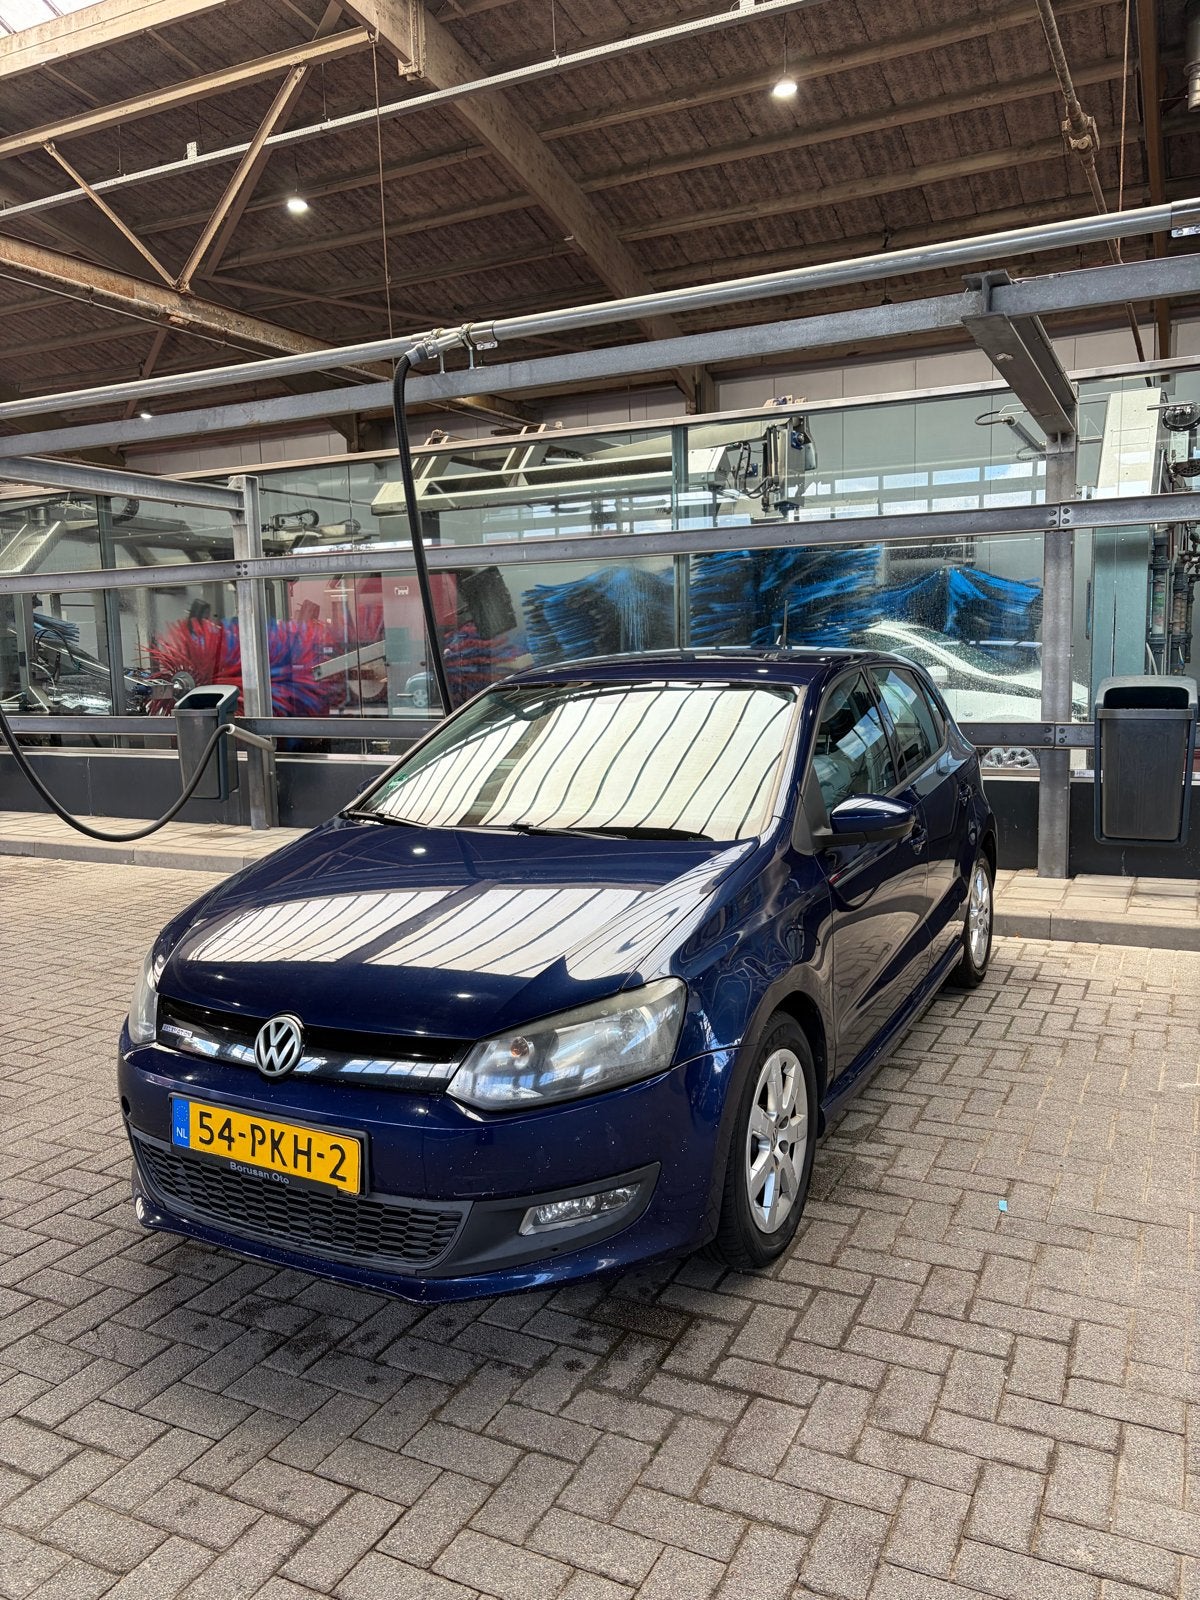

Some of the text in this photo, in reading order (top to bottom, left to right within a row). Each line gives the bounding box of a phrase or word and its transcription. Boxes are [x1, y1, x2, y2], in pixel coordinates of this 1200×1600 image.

[176, 1126, 188, 1140] NL
[198, 1110, 348, 1183] 54-PKH-2
[229, 1161, 290, 1185] Borusan Oto
